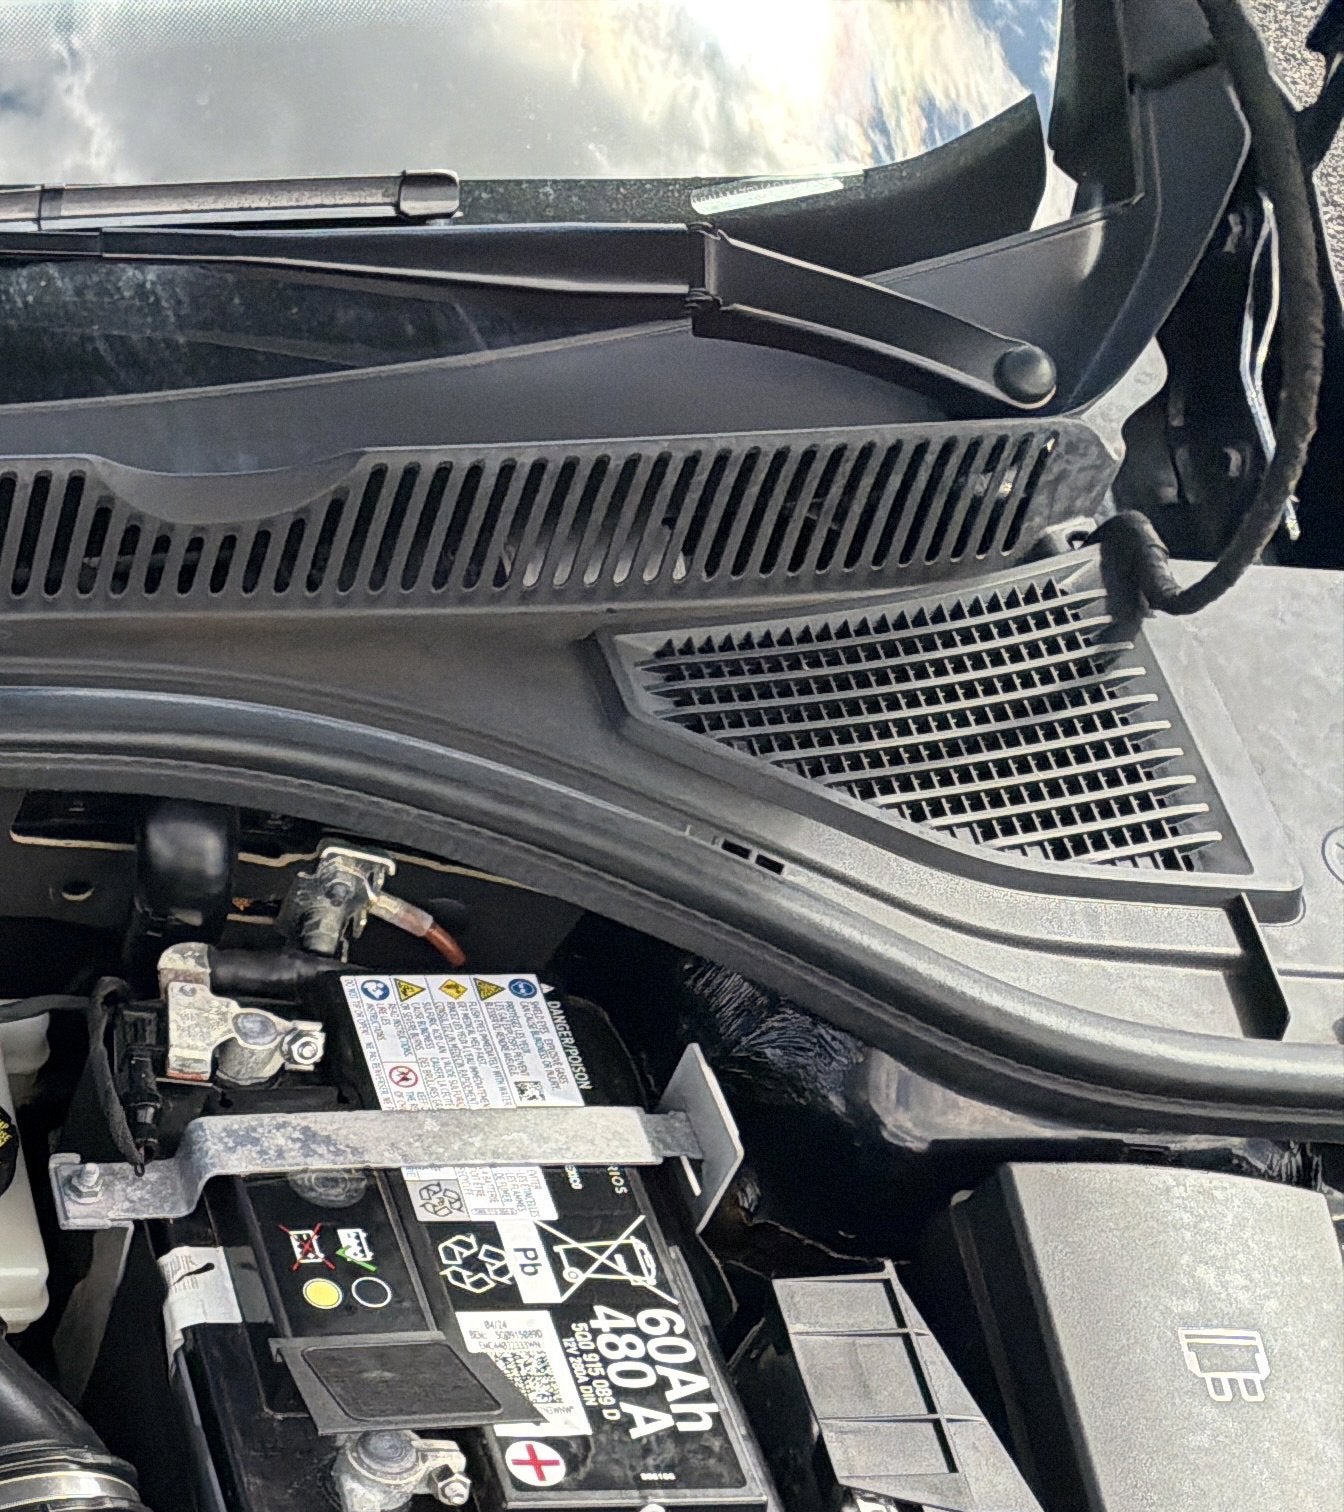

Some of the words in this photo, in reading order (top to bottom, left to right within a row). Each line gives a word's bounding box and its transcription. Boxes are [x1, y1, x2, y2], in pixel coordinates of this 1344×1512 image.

[547, 1000, 591, 1089] DANGER/POISON
[513, 1247, 541, 1277] Pb
[569, 1322, 595, 1350] 5Q0
[587, 1306, 656, 1388] 480
[561, 1338, 580, 1354] 12V
[578, 1385, 598, 1406] DIN
[580, 1352, 605, 1376] 915
[633, 1306, 720, 1432] 60Ah
[590, 1379, 615, 1403] 089
[601, 1407, 622, 1421] D
[618, 1403, 675, 1439] A
